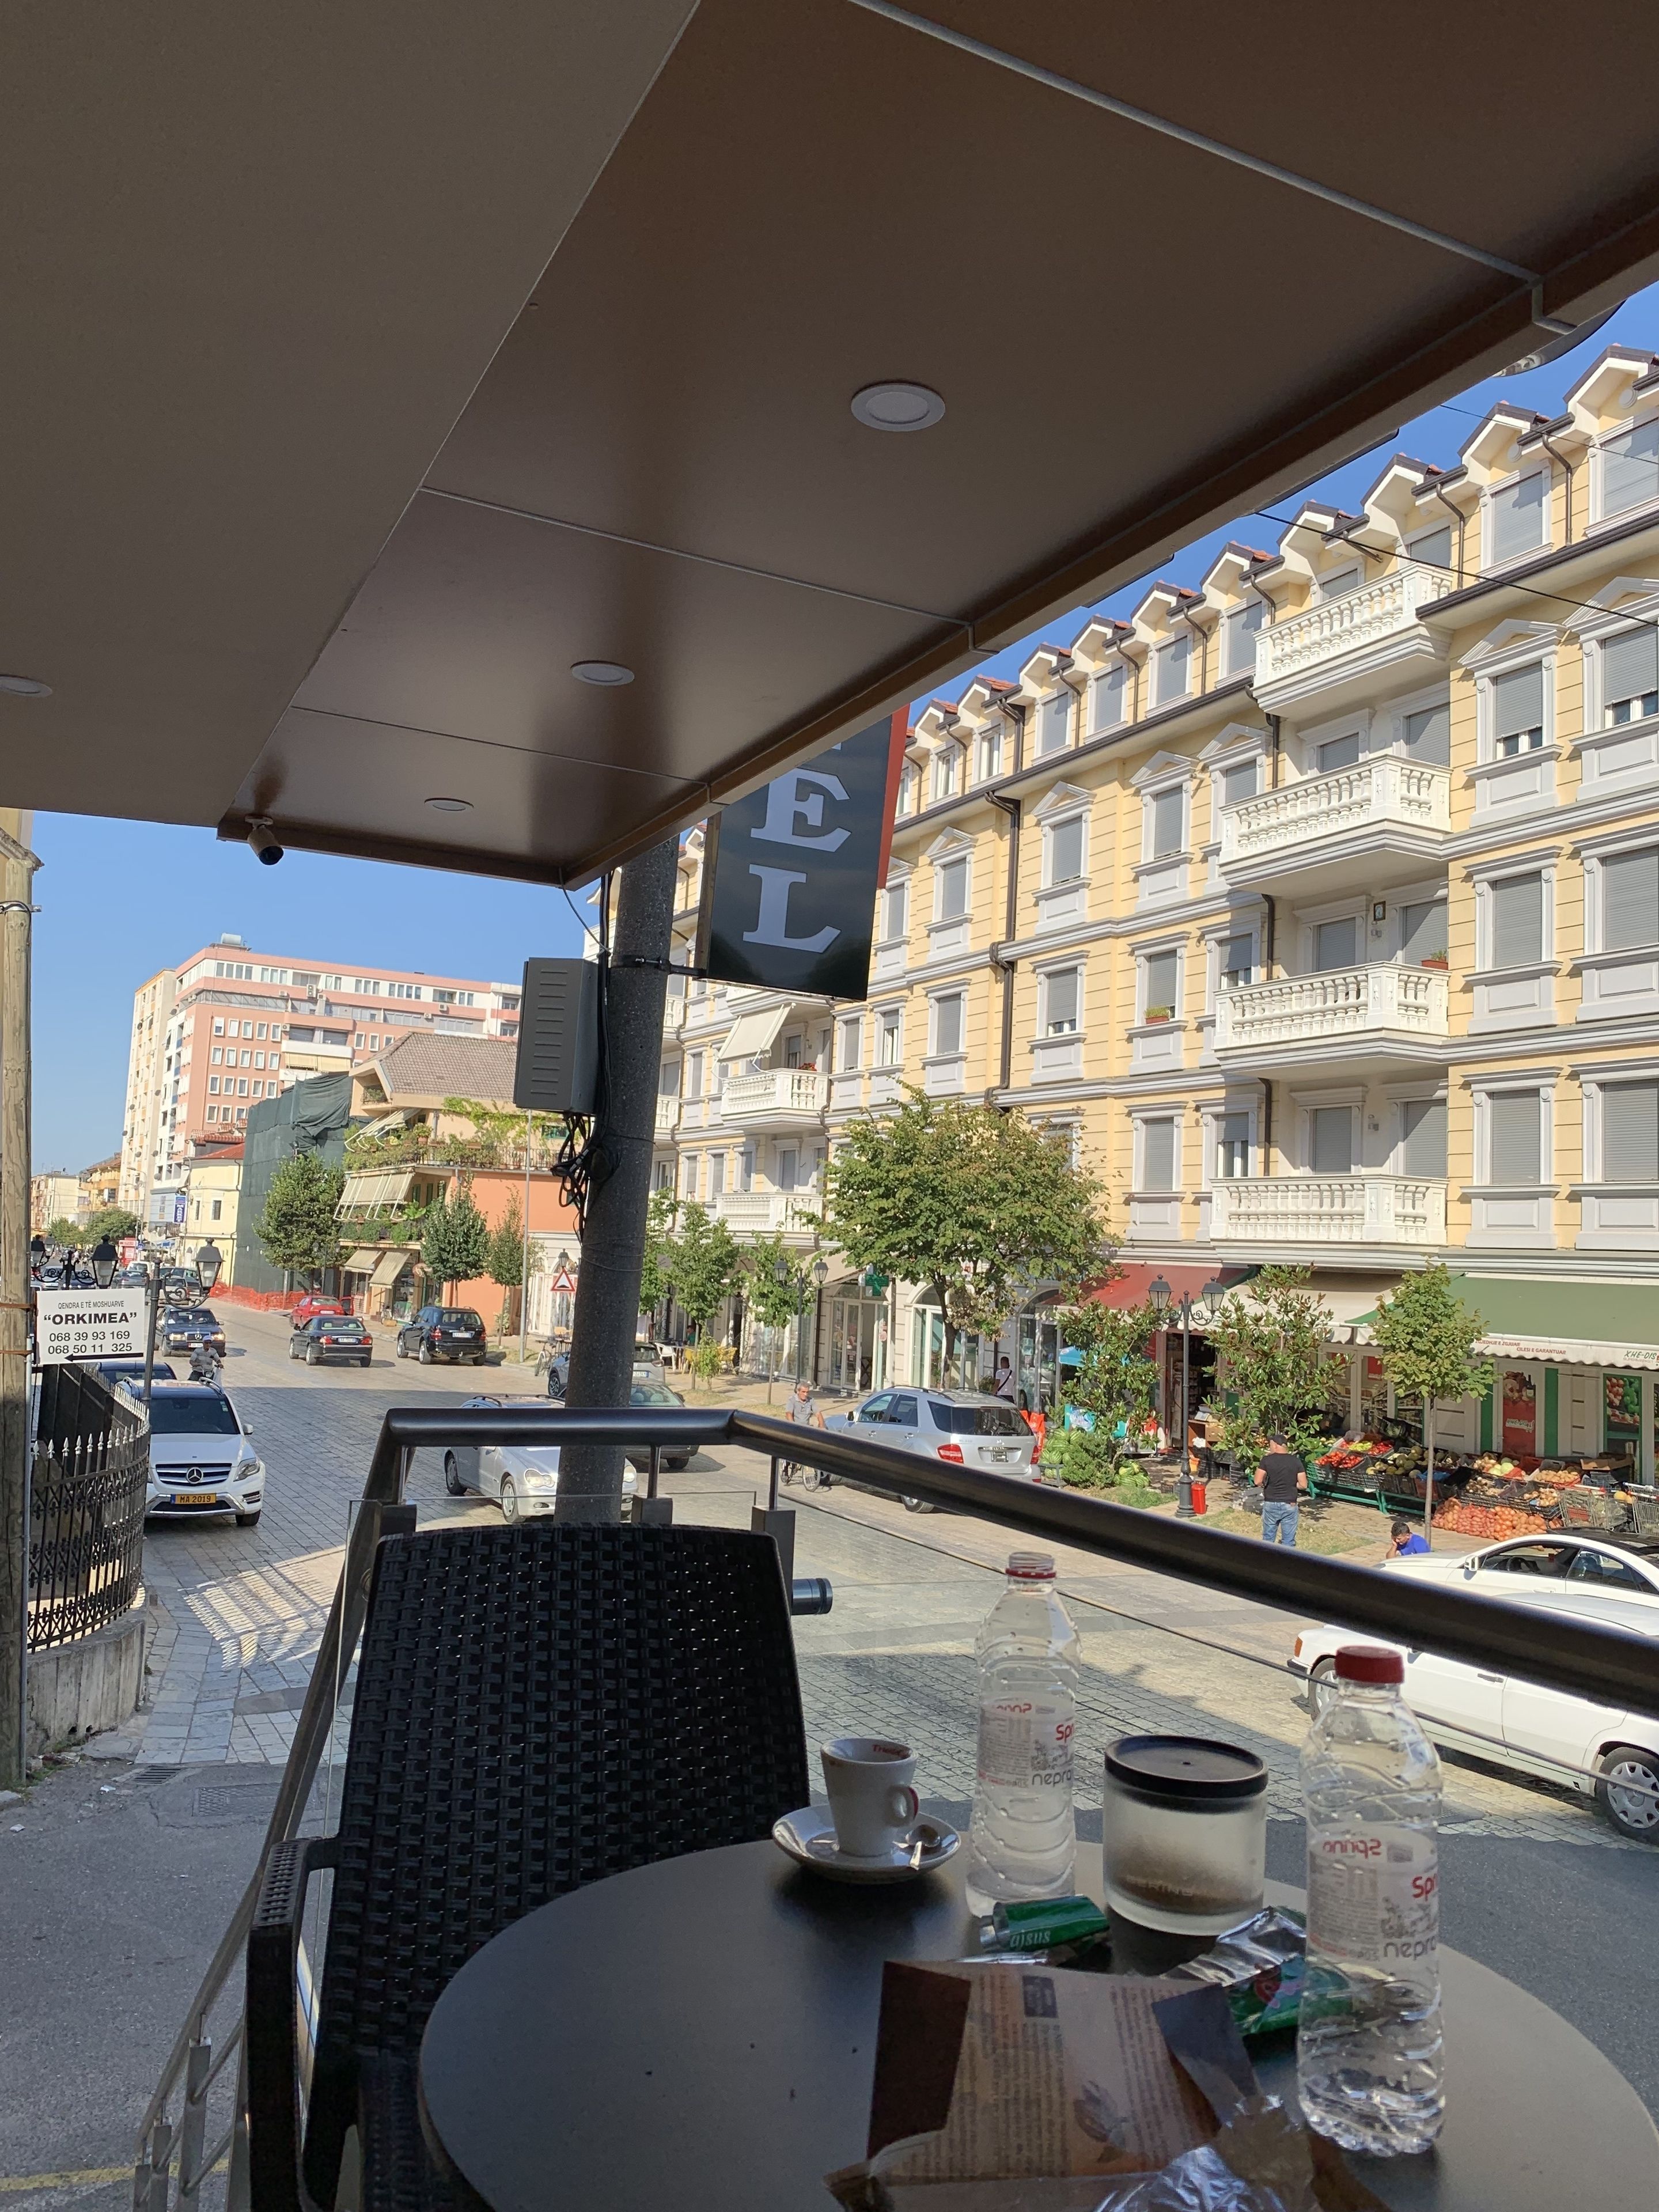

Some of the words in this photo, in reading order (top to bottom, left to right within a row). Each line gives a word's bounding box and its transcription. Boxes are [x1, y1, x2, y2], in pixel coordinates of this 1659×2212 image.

[86, 1300, 92, 1308] TË
[50, 1332, 70, 1342] 068
[74, 1332, 88, 1341] 39
[92, 1331, 105, 1340] 93
[110, 1331, 130, 1339] 169
[48, 1345, 69, 1354] 068
[73, 1344, 87, 1353] 50
[92, 1344, 104, 1353] 11
[111, 1343, 132, 1352] 325
[192, 1495, 211, 1503] 2019
